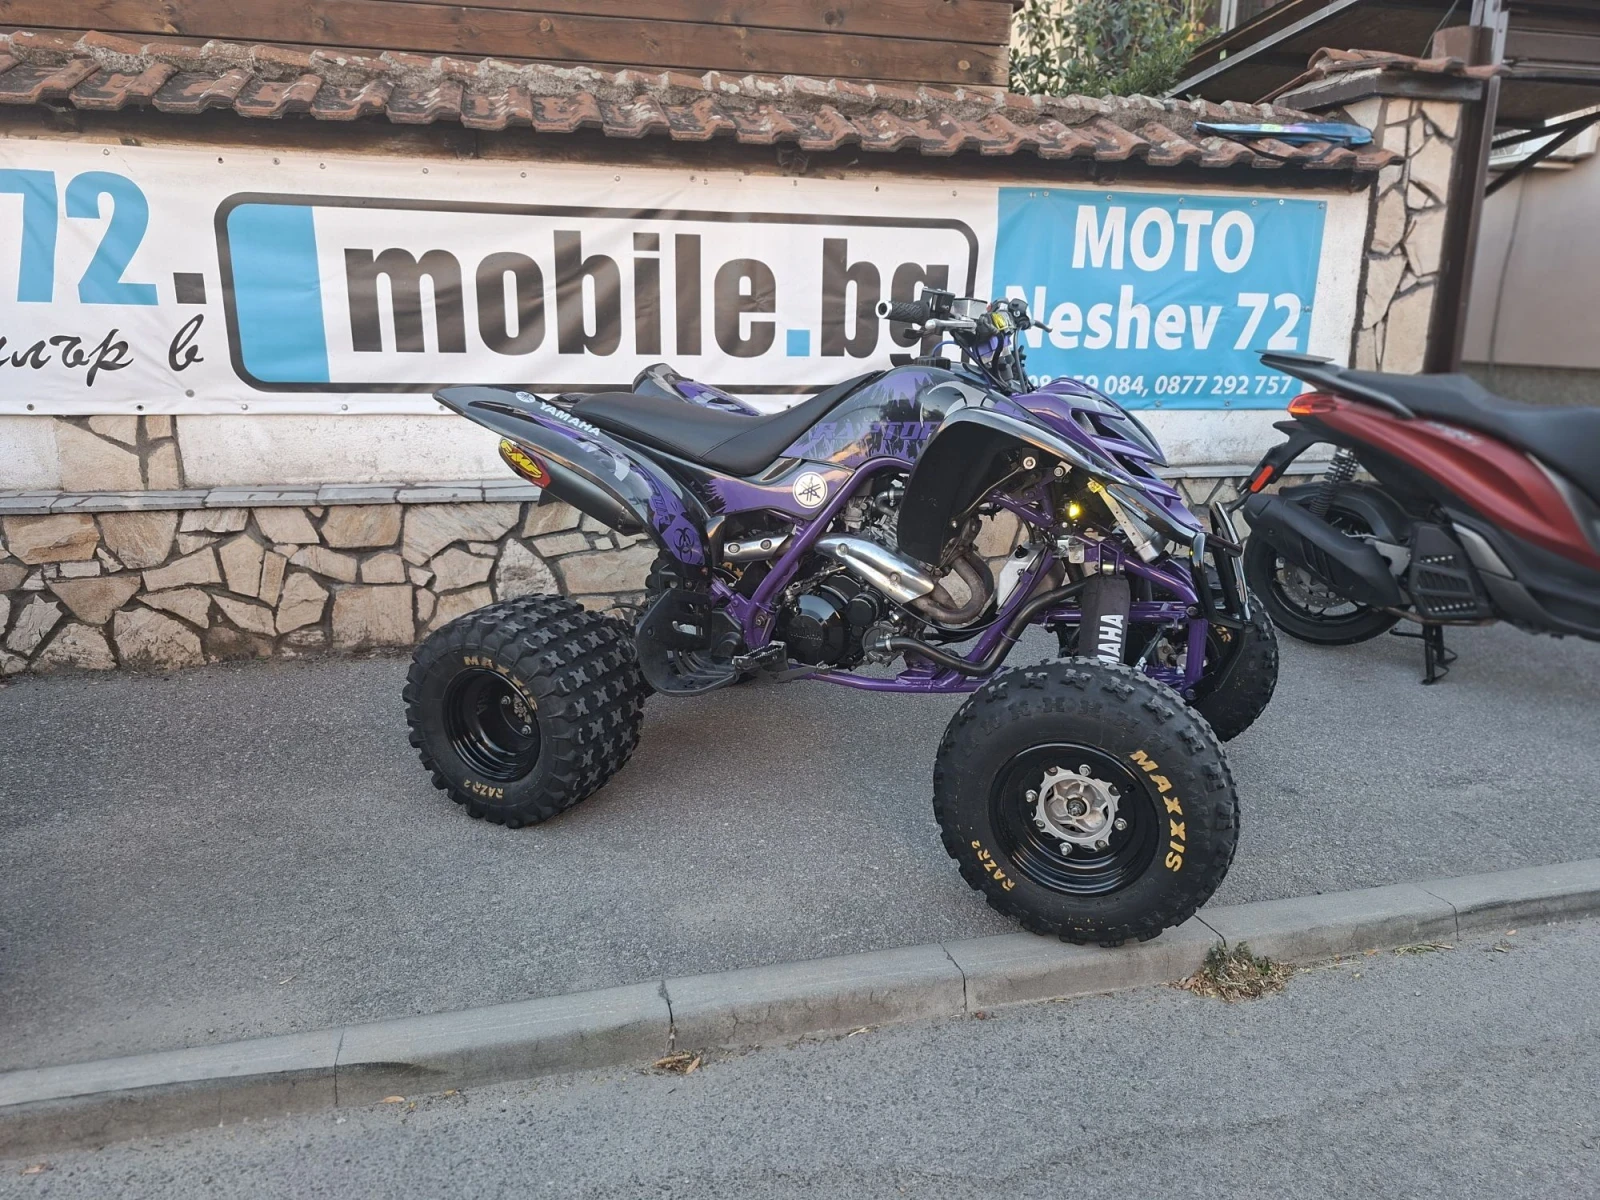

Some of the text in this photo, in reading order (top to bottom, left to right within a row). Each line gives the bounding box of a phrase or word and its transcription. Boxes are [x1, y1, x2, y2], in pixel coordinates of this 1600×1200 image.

[1072, 204, 1255, 273] MOTO
[168, 313, 205, 372] в
[1004, 284, 1302, 351] Neshev 72
[1103, 374, 1150, 398] 084,
[1153, 374, 1209, 395] 0877
[1210, 374, 1251, 395] 292
[1254, 374, 1294, 395] 757
[539, 401, 602, 437] YAMAHA
[1129, 749, 1186, 872] MAXXIS
[977, 848, 1016, 892] RAZR
